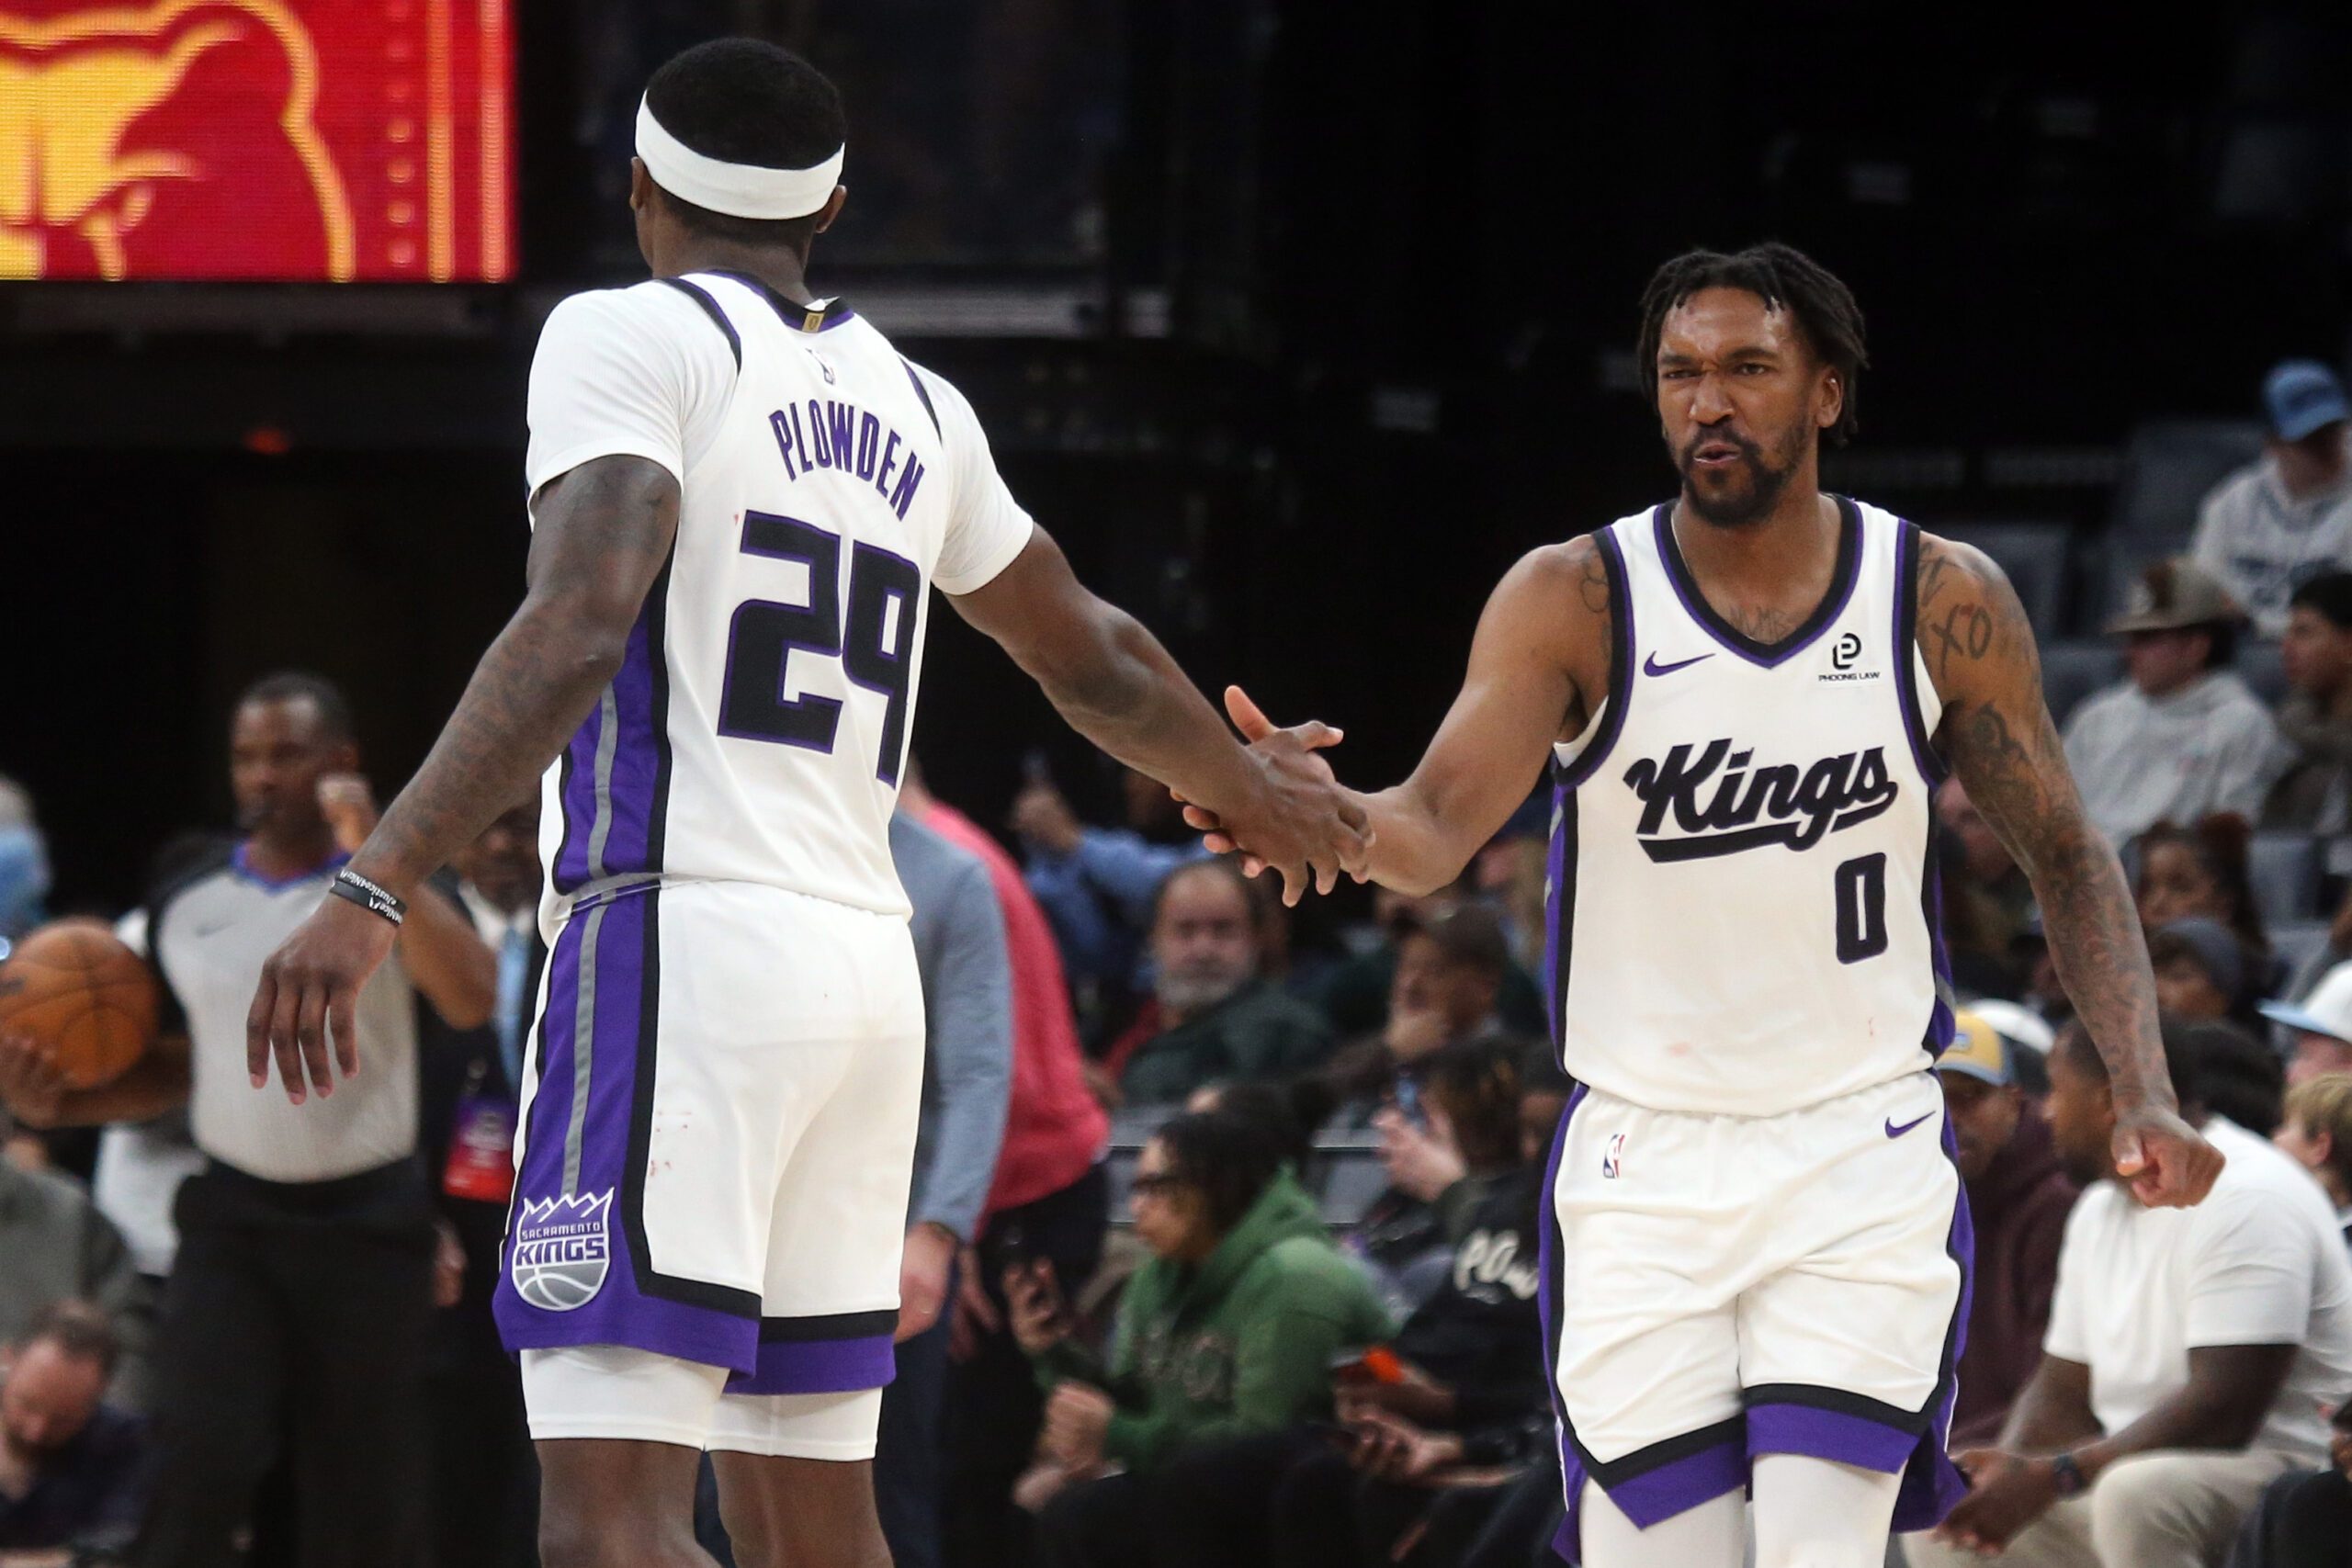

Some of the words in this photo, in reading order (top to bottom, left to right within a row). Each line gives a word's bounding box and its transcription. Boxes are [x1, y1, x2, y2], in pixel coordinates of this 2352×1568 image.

[769, 399, 925, 522] PLOWDEN
[717, 509, 922, 790] 29
[1859, 671, 1881, 681] LAW
[1623, 738, 1899, 863] Kings
[1836, 852, 1889, 965] 0
[515, 1236, 605, 1266] KINGS
[521, 1222, 600, 1240] SACRAMENTO
